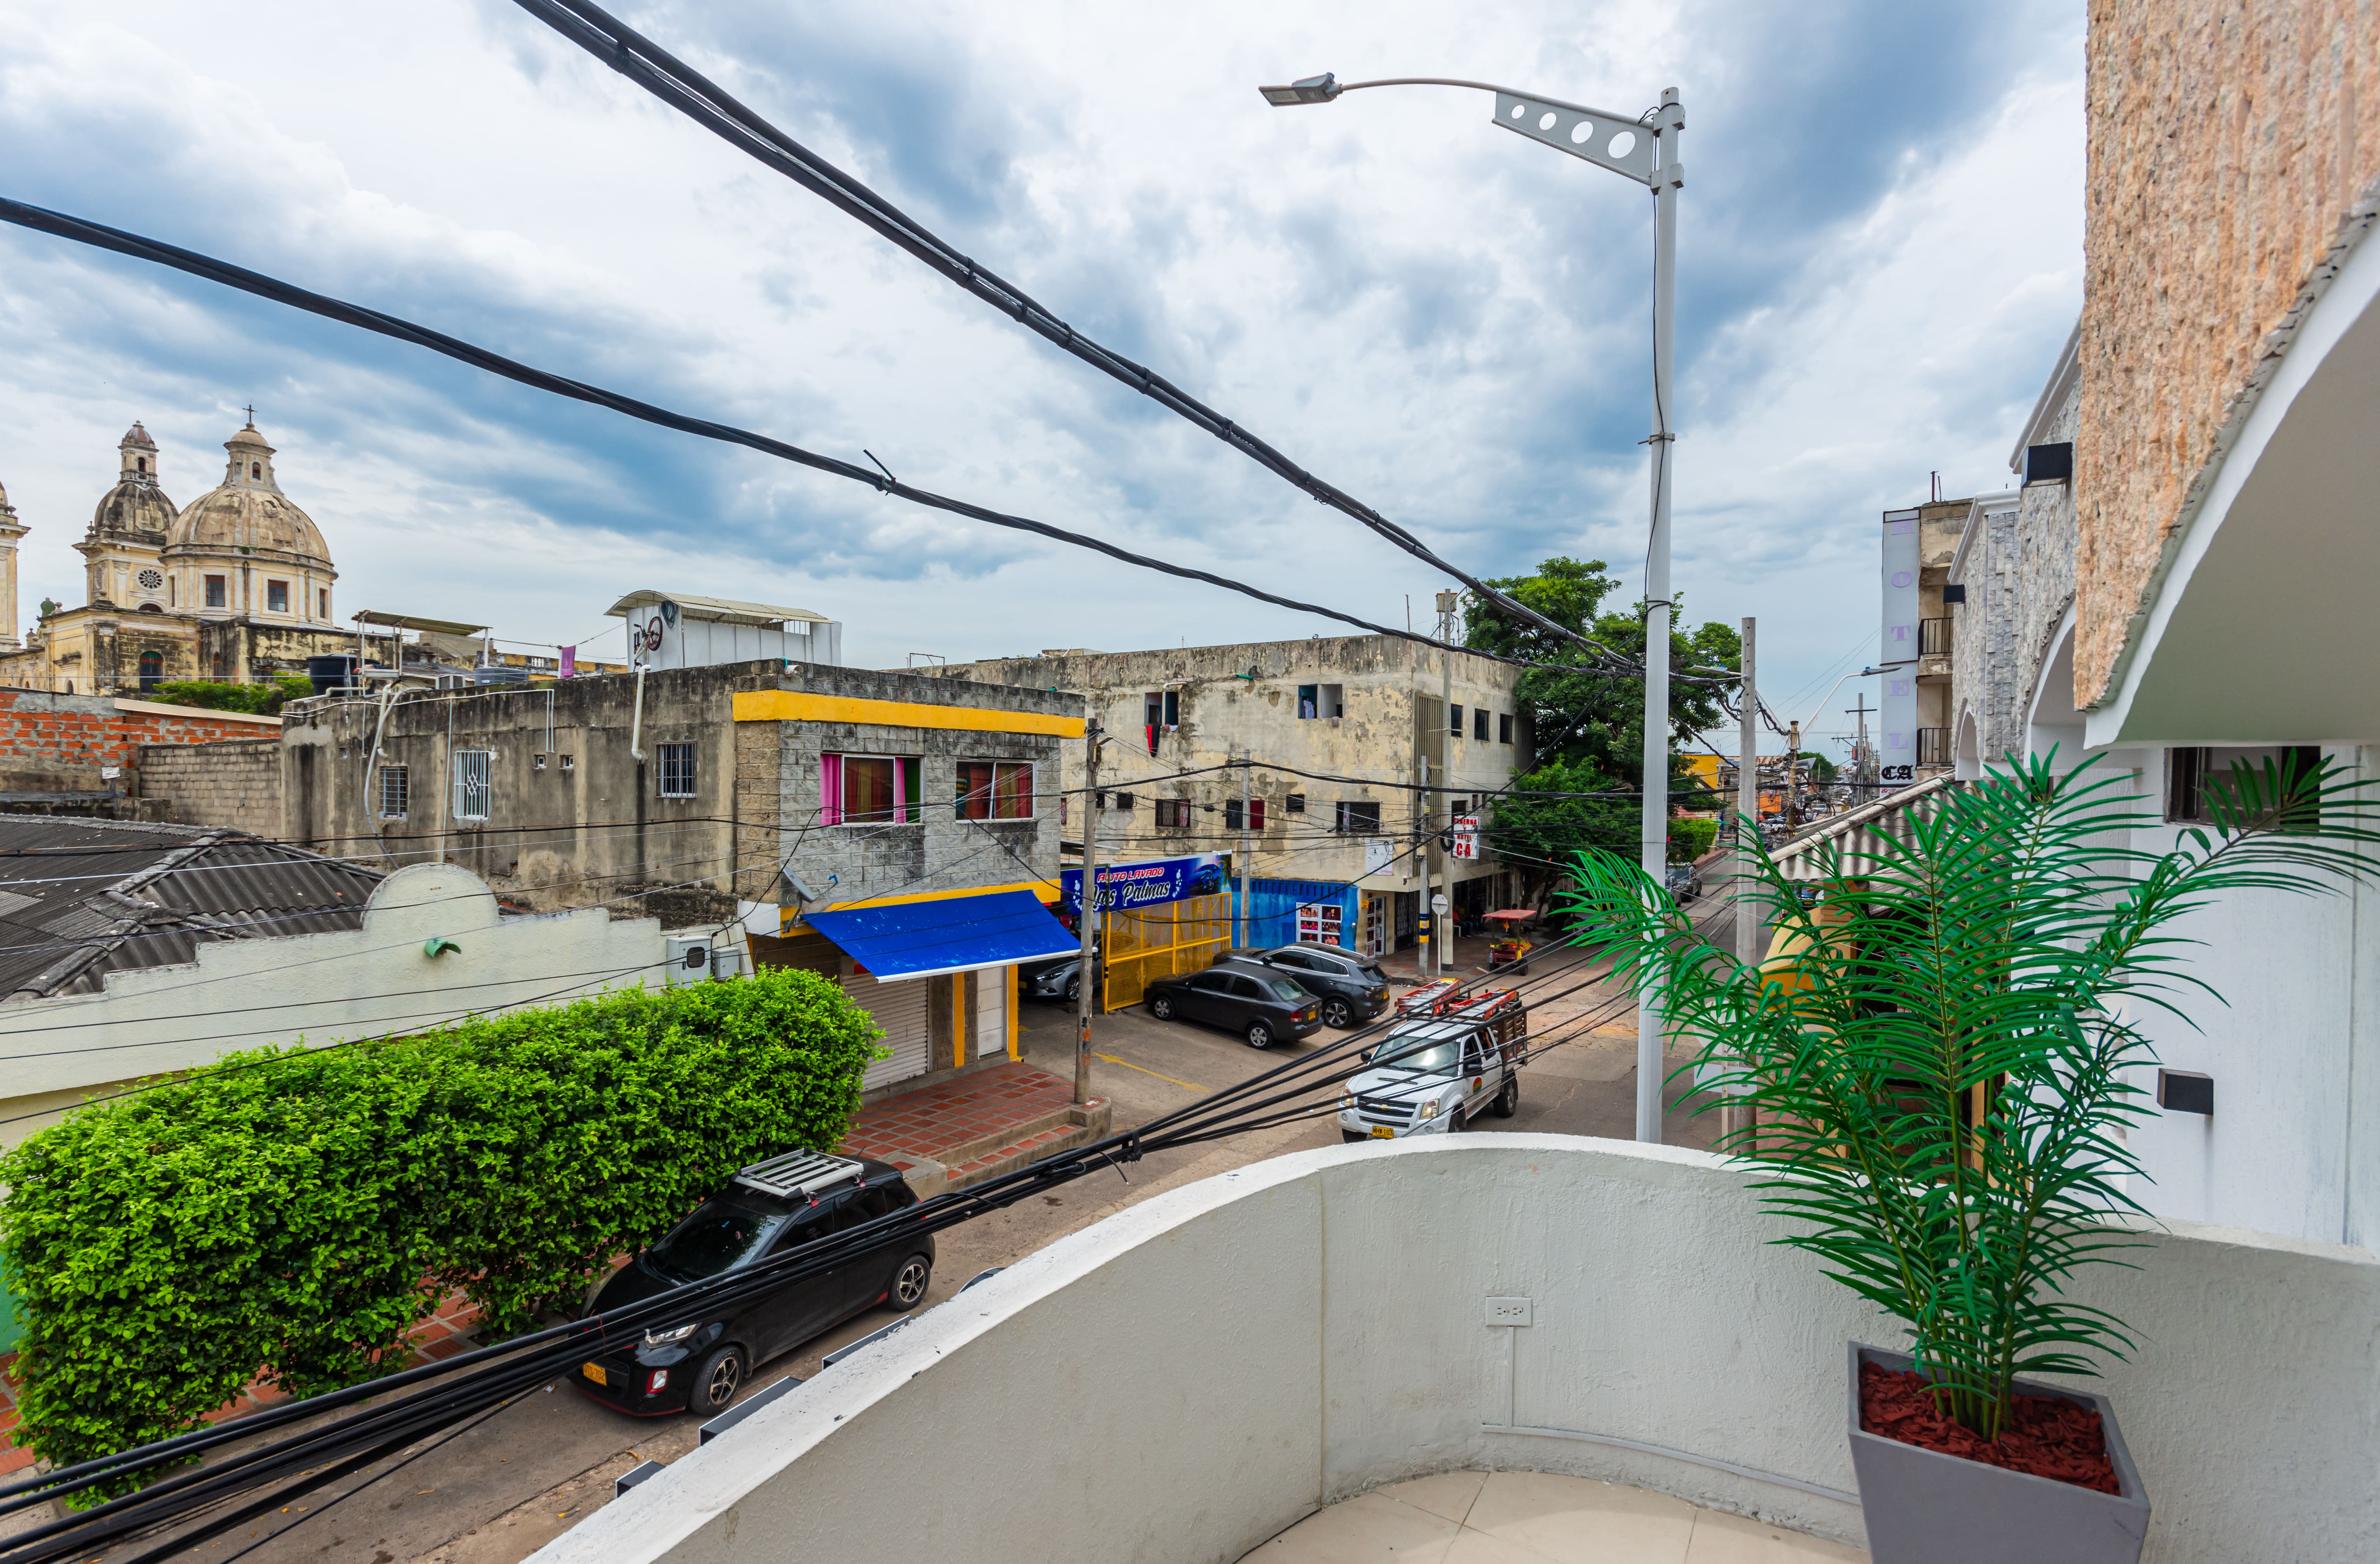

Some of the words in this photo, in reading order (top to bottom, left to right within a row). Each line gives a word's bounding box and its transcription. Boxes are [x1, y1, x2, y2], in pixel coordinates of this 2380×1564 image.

[1889, 520, 1915, 749] HOTEL
[1097, 872, 1127, 883] AUTO
[1128, 867, 1164, 879] LAVADO
[1122, 881, 1171, 906] Palmas
